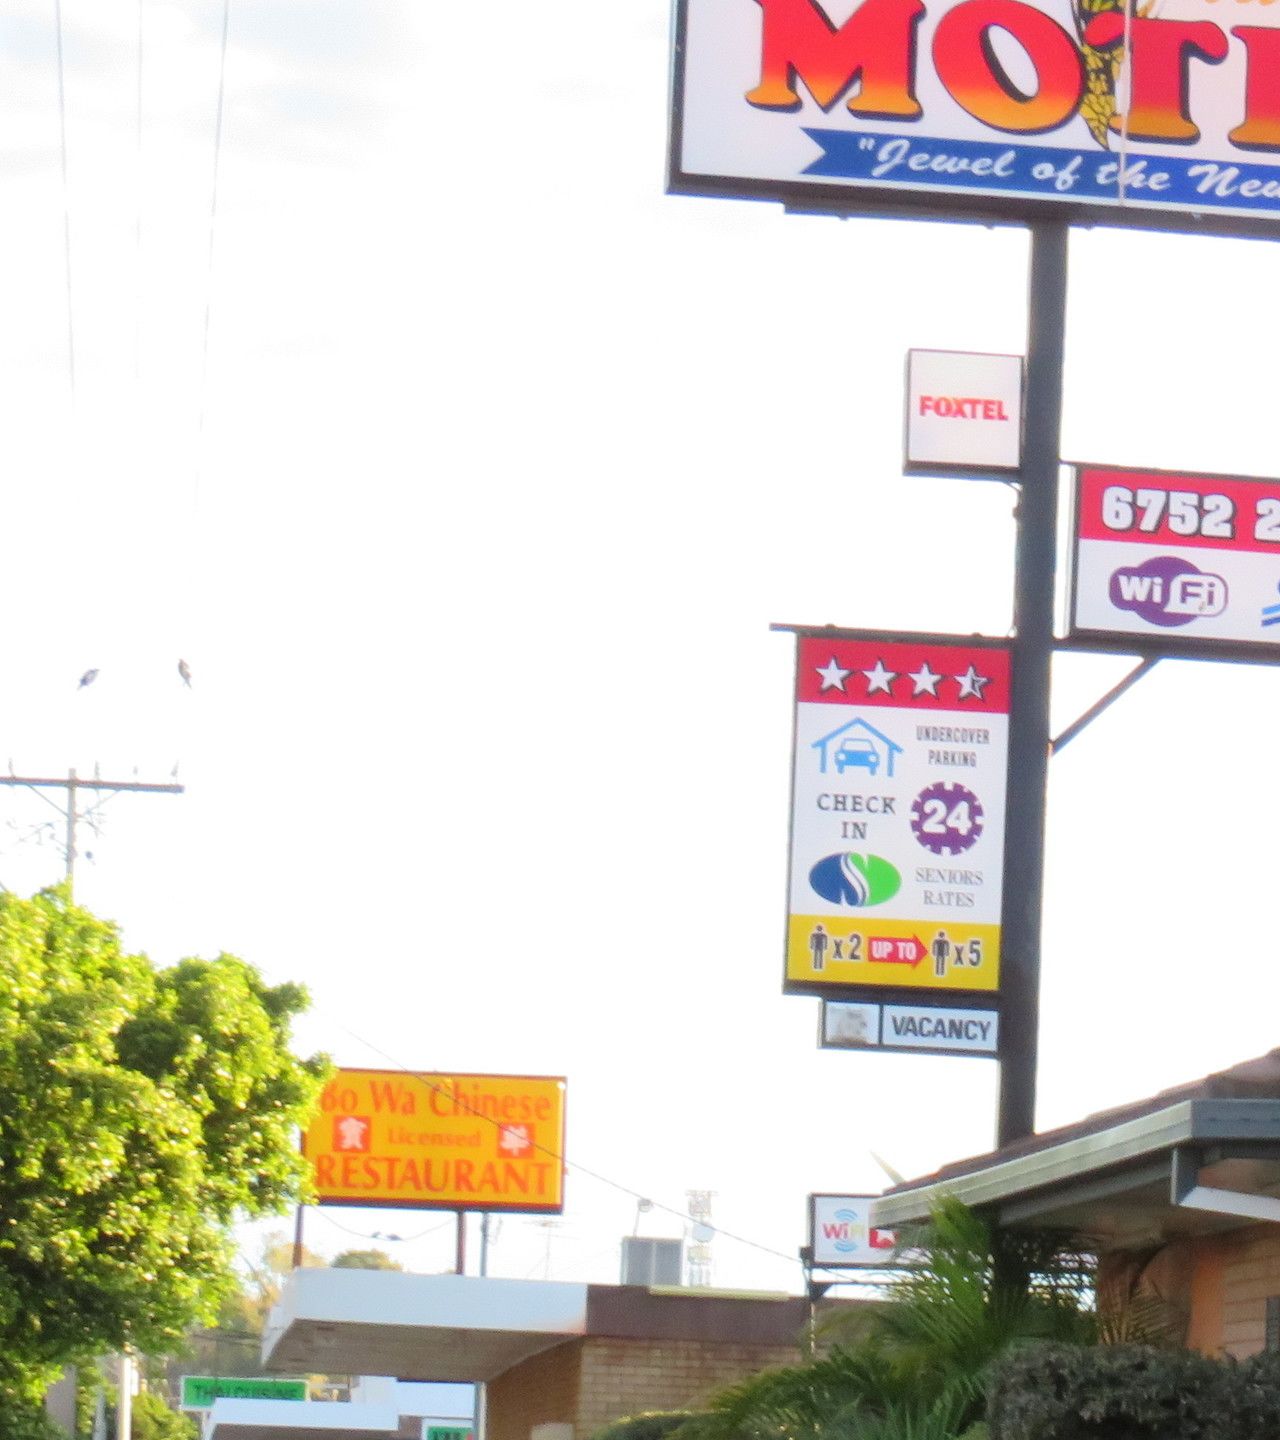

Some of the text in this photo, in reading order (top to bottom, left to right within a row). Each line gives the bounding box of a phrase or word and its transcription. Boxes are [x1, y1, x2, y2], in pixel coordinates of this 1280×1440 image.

[1032, 155, 1083, 191] of
[919, 395, 1009, 421] FOXTEL
[1101, 486, 1236, 539] 6752
[916, 725, 990, 745] UNDERCOVER
[928, 749, 977, 767] PARKING
[816, 793, 896, 815] CHECK
[921, 798, 973, 836] 24
[841, 821, 867, 840] IN
[916, 867, 984, 886] SENIORS
[923, 890, 975, 907] RATES
[849, 933, 862, 960] 2
[871, 940, 893, 959] UP
[896, 941, 918, 961] TO
[968, 940, 982, 967] 5
[891, 1014, 992, 1042] VACANCY
[369, 1080, 417, 1115] Wa
[429, 1081, 553, 1121] Chinese
[315, 1155, 552, 1196] RESTAURANT
